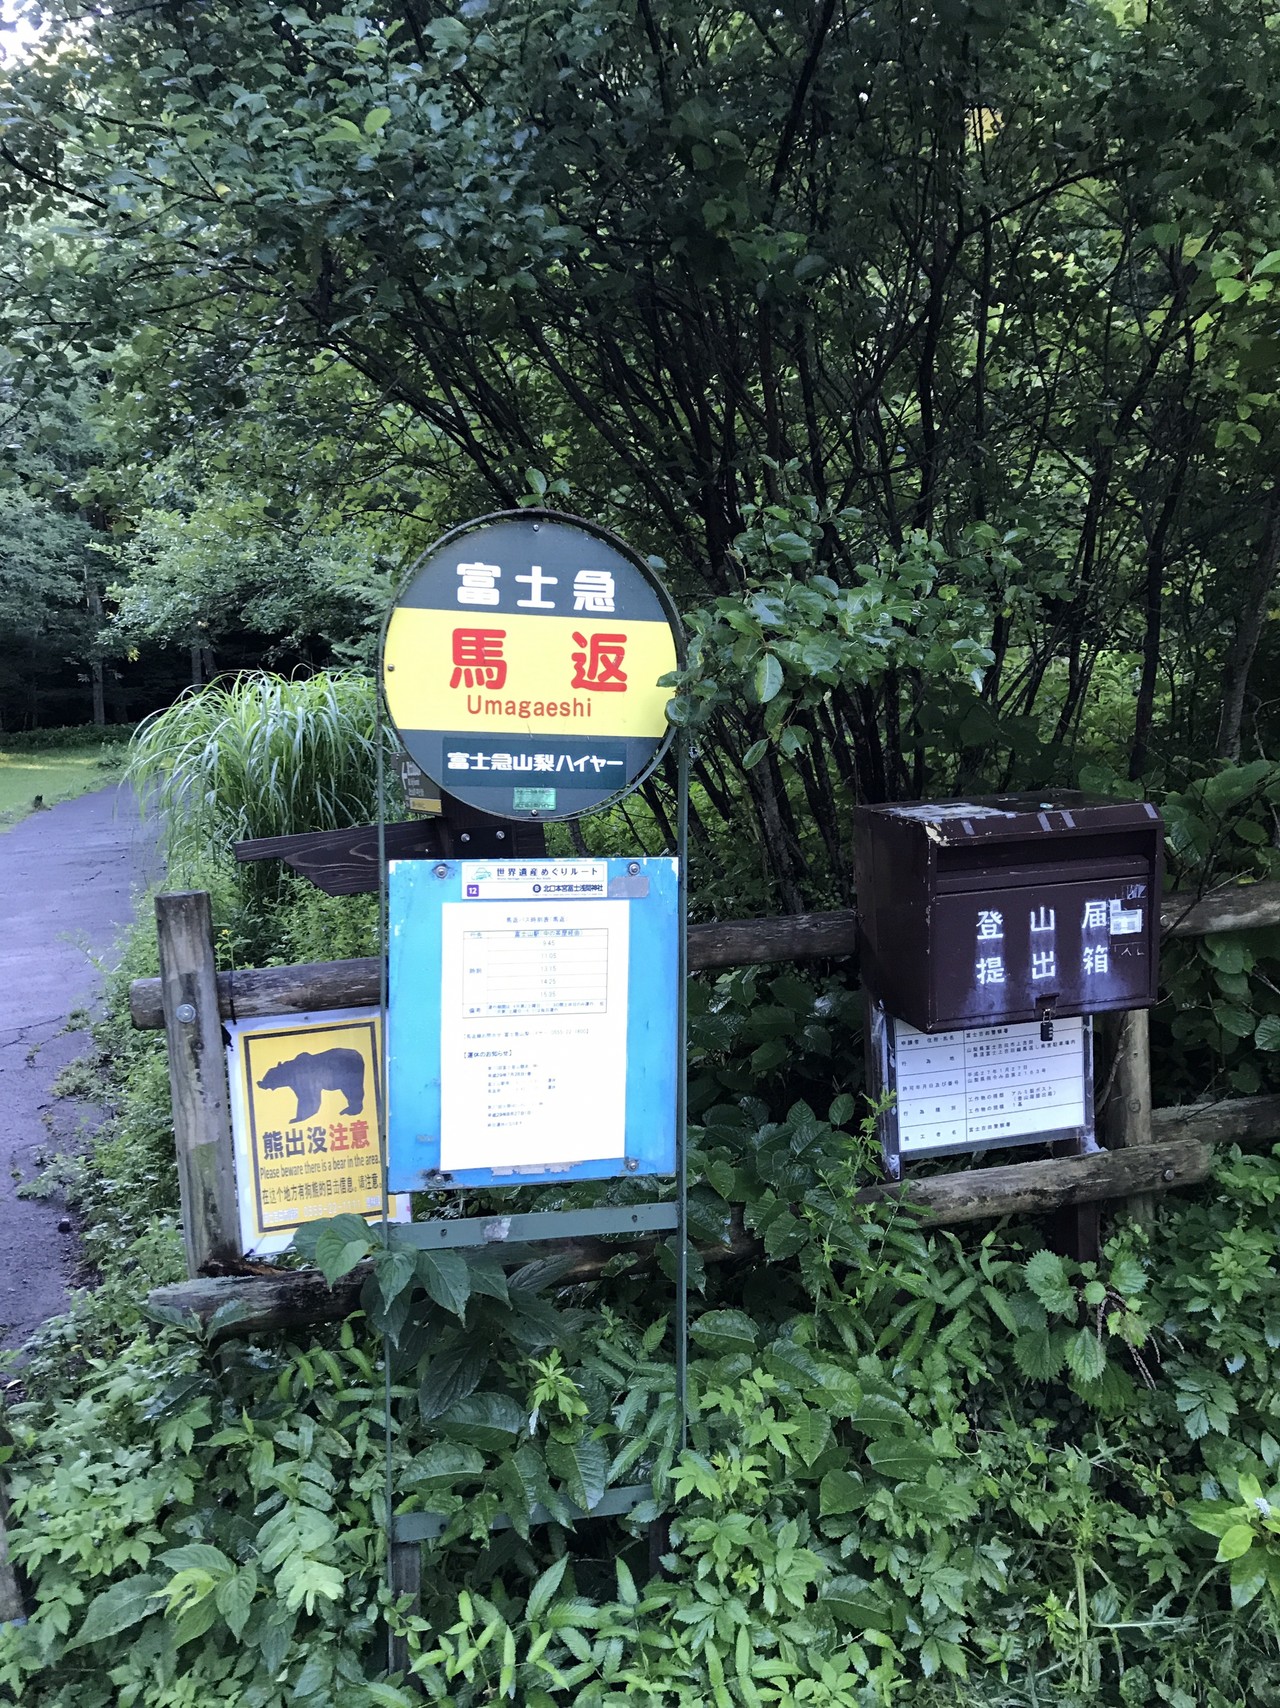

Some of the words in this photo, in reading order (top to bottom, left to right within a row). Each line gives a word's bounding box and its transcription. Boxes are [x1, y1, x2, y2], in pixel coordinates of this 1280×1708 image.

[456, 562, 615, 612] 富士急
[449, 628, 627, 692] 馬返
[467, 694, 592, 719] Umagaeshi
[447, 752, 624, 773] 富士急山梨ハイヤー
[497, 867, 598, 877] 世界遺産めぐりルート
[976, 900, 1108, 940] 登山届
[976, 944, 1108, 985] 提出箱
[263, 1119, 370, 1160] 熊出没注意
[260, 1166, 280, 1180] Please
[280, 1163, 304, 1178] beware
[304, 1160, 321, 1174] there
[321, 1159, 327, 1172] is
[333, 1157, 346, 1170] bear
[347, 1155, 353, 1168] in
[354, 1153, 365, 1167] the
